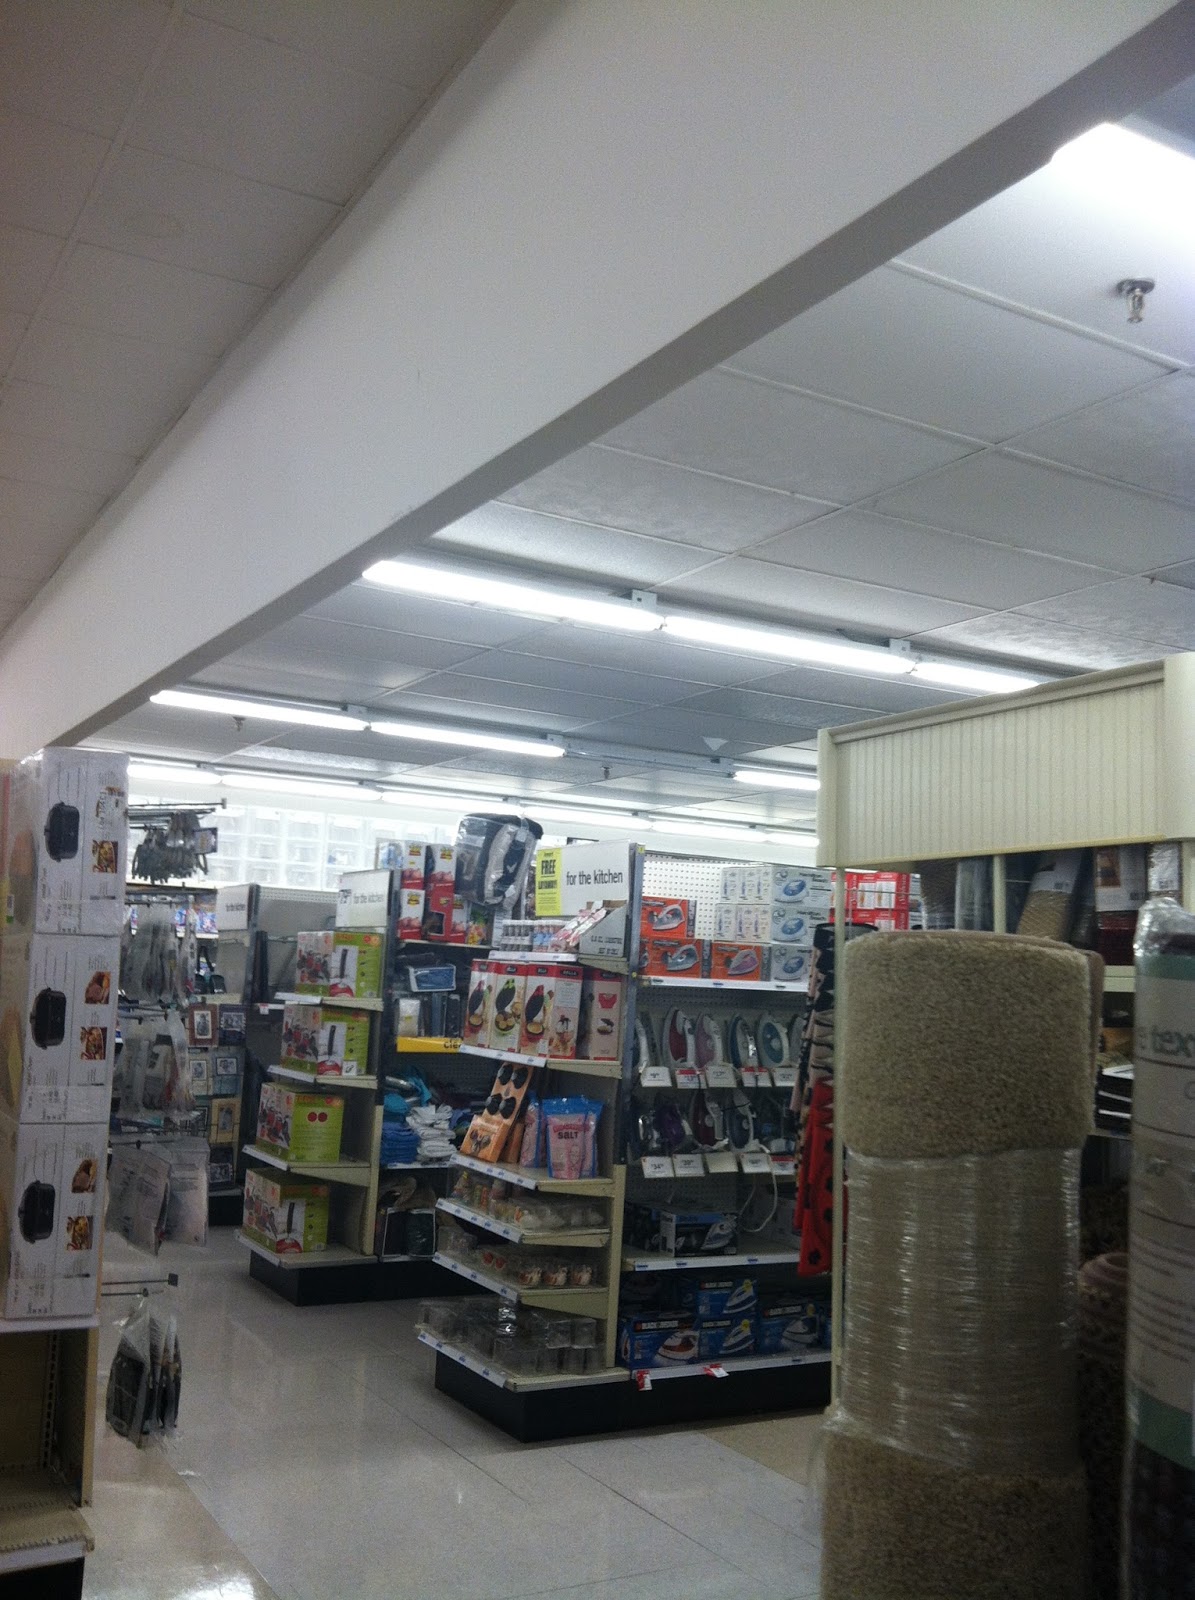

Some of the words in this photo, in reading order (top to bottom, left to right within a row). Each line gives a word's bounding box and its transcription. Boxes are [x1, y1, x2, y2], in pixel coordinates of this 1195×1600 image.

[541, 859, 556, 875] FREE
[566, 871, 577, 886] for
[579, 870, 592, 886] the
[593, 868, 623, 885] kitchen
